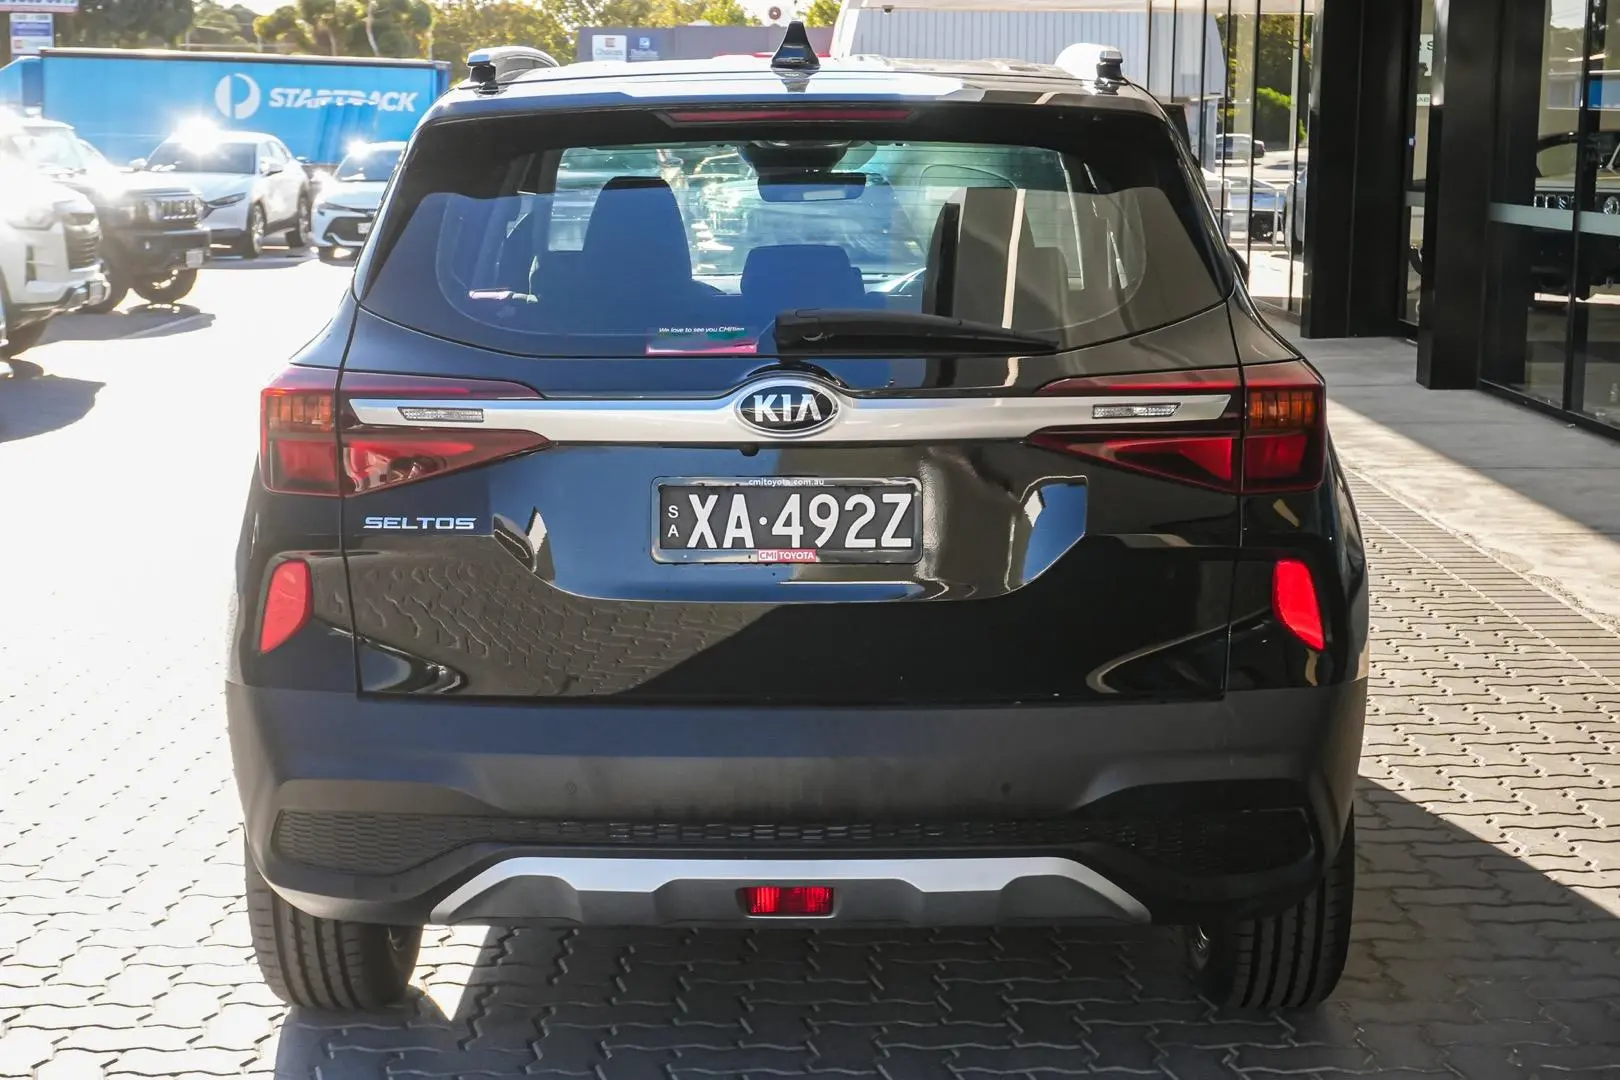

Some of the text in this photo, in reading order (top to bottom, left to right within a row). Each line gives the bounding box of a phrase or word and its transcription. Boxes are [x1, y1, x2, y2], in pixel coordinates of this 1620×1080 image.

[268, 87, 419, 112] STARTRACK
[753, 393, 822, 422] KIA
[748, 477, 825, 487] cmitoyota.com.au
[362, 516, 478, 530] SELTOS
[759, 551, 815, 560] CMI TOYOTA
